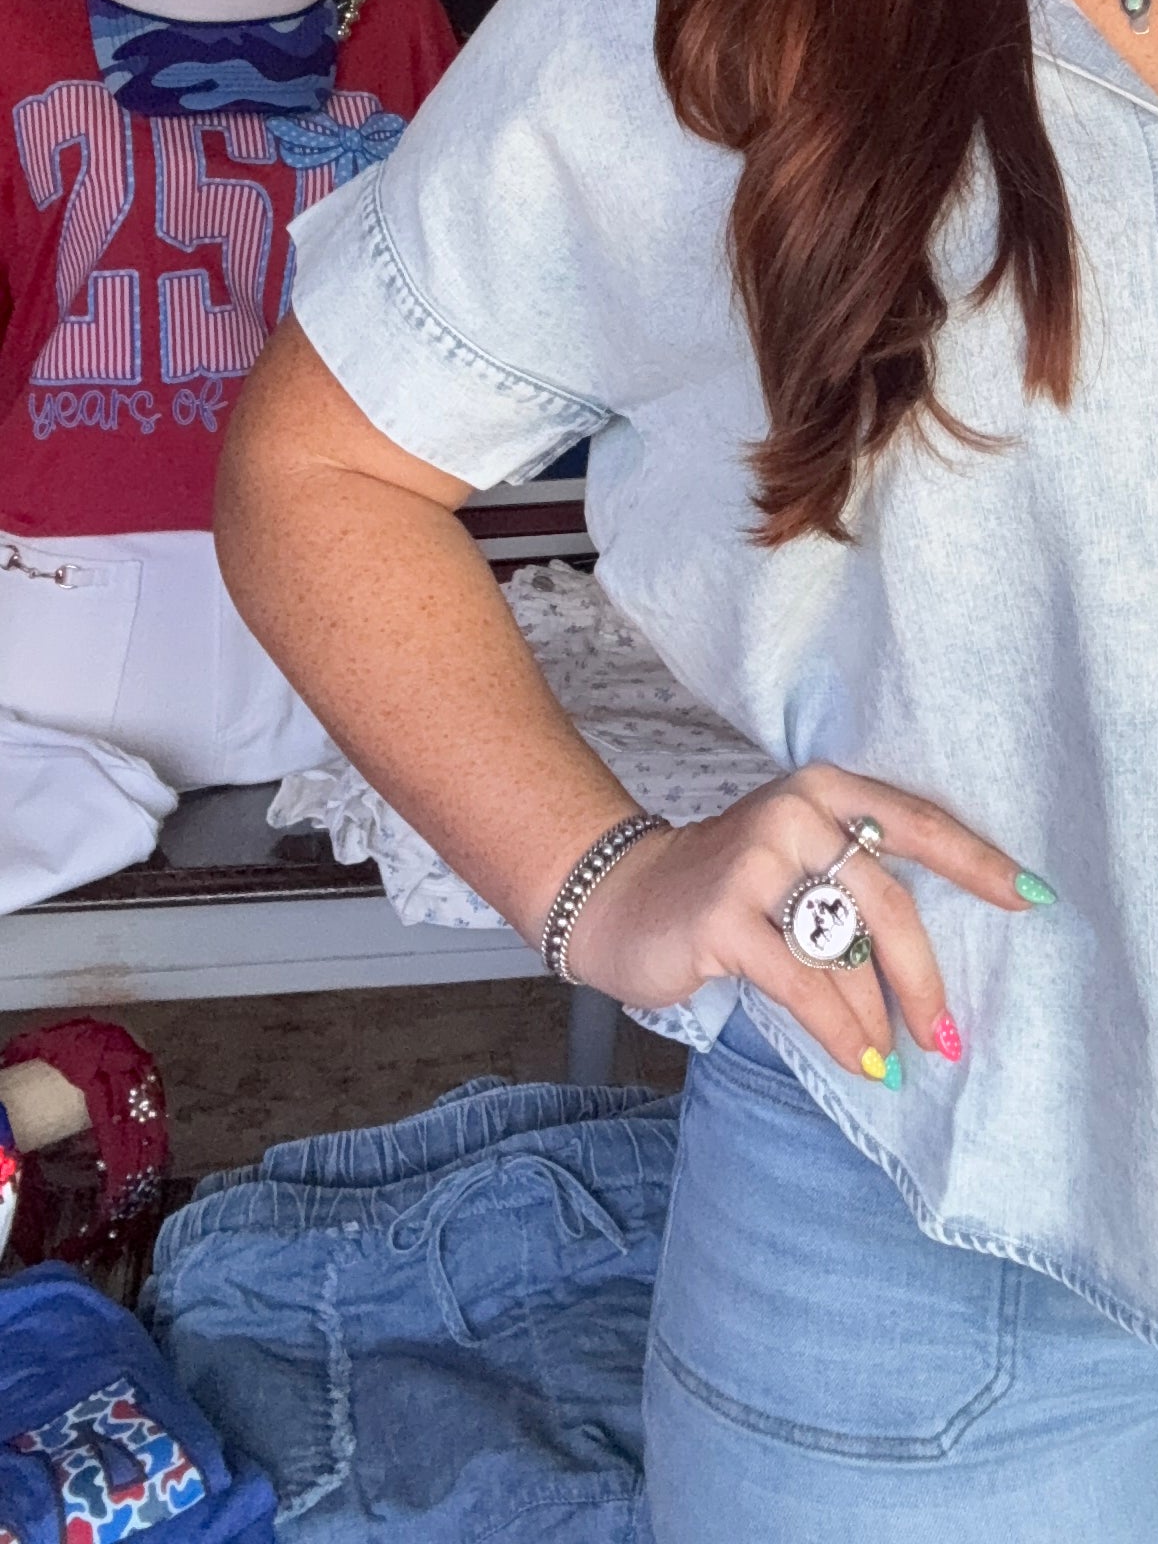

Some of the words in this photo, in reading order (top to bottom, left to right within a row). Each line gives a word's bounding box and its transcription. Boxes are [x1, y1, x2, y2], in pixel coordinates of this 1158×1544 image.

[12, 79, 384, 386] 25
[28, 388, 162, 441] years
[172, 377, 228, 433] of
